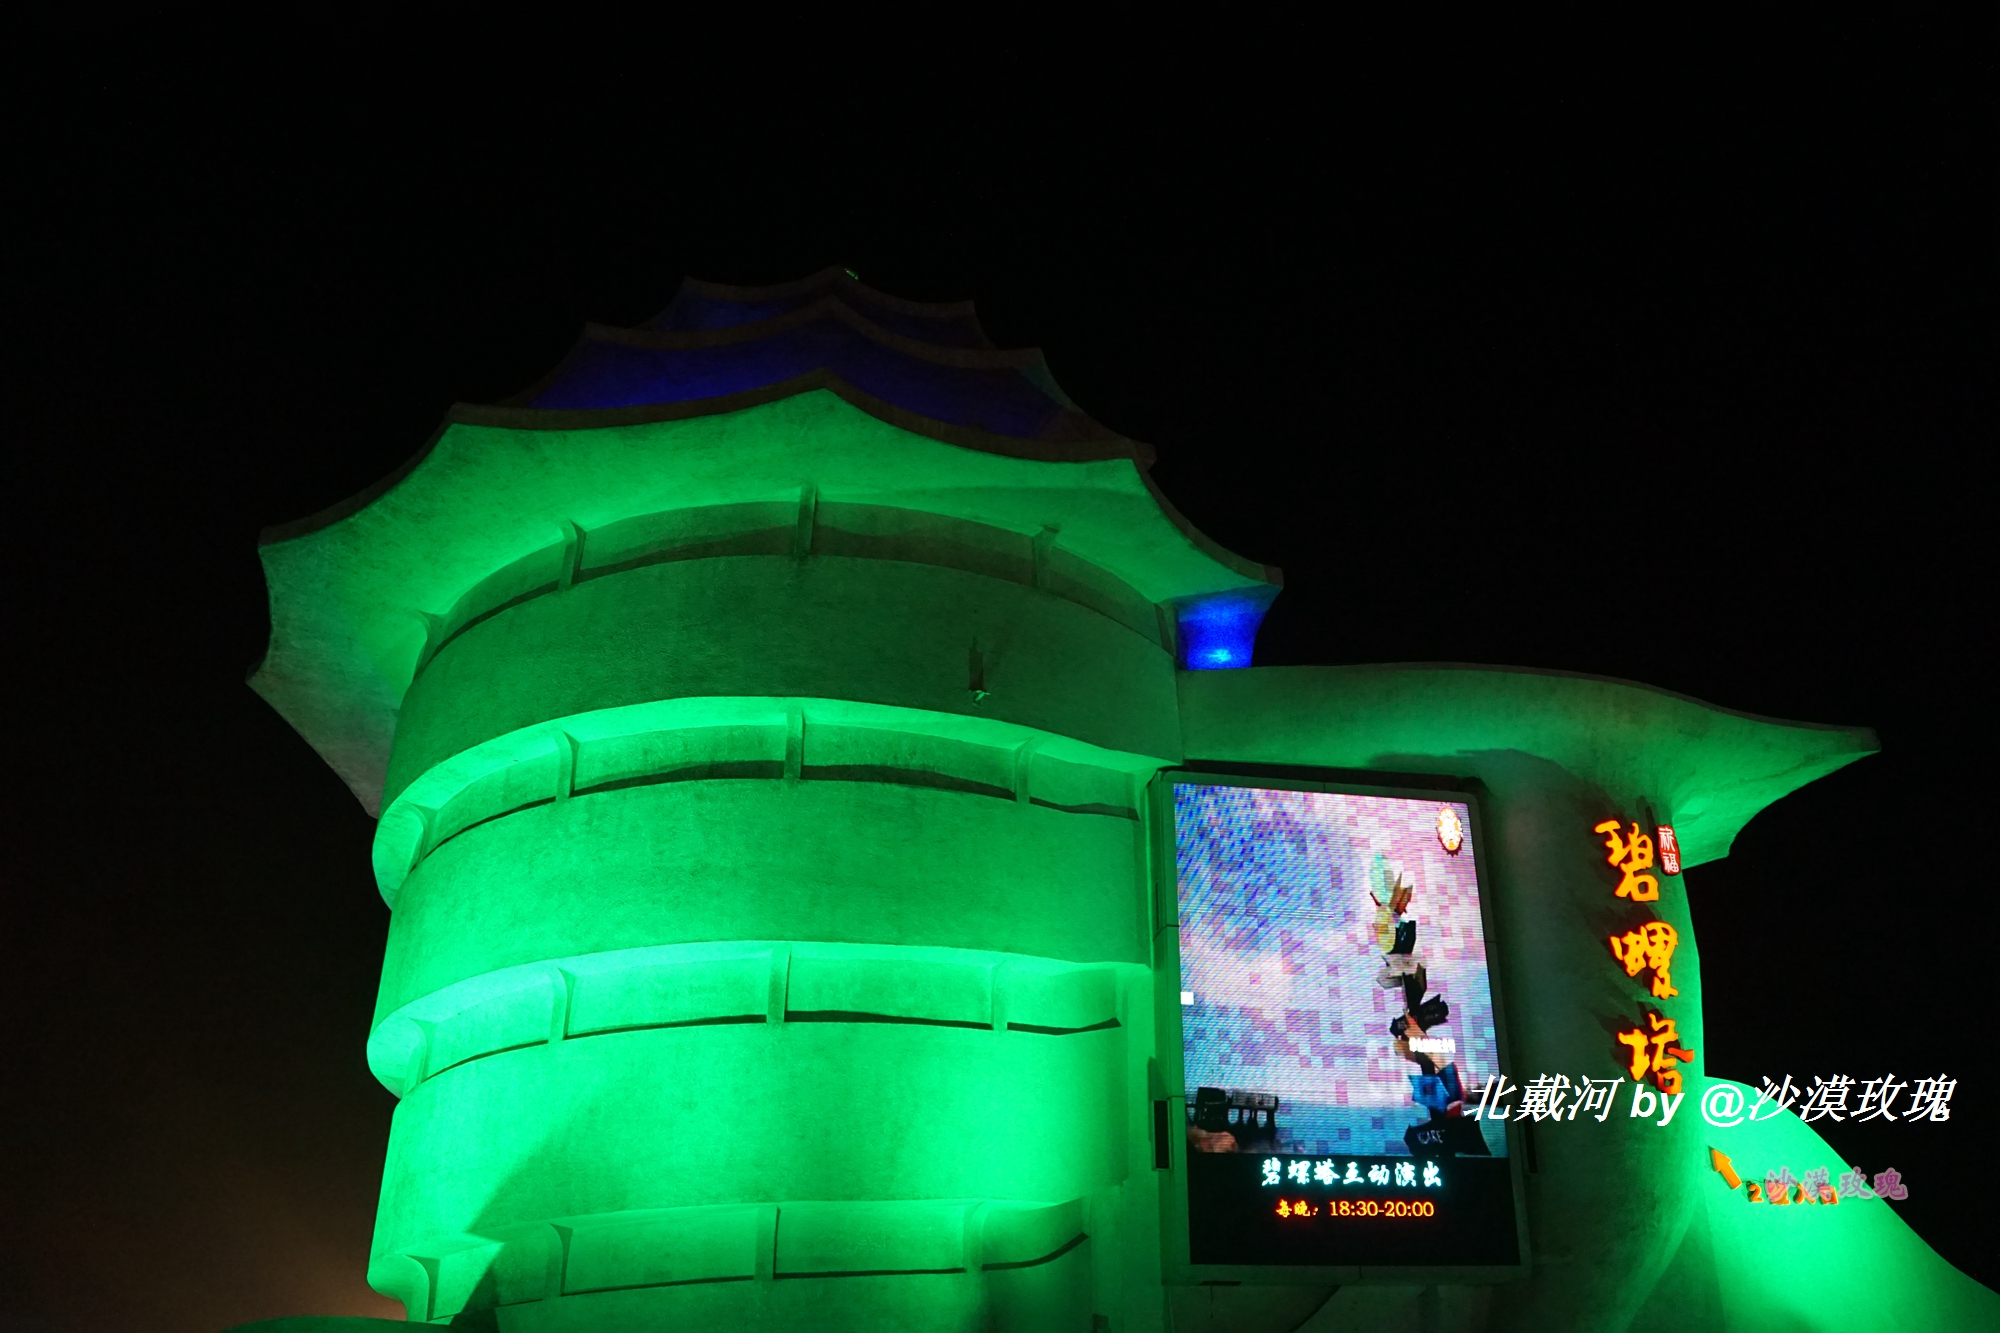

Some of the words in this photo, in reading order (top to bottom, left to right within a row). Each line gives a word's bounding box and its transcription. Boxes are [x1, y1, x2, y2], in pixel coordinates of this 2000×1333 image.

[1261, 1157, 1443, 1188] 碧螺塔互动演出
[1329, 1200, 1435, 1218] 18:30-20:00
